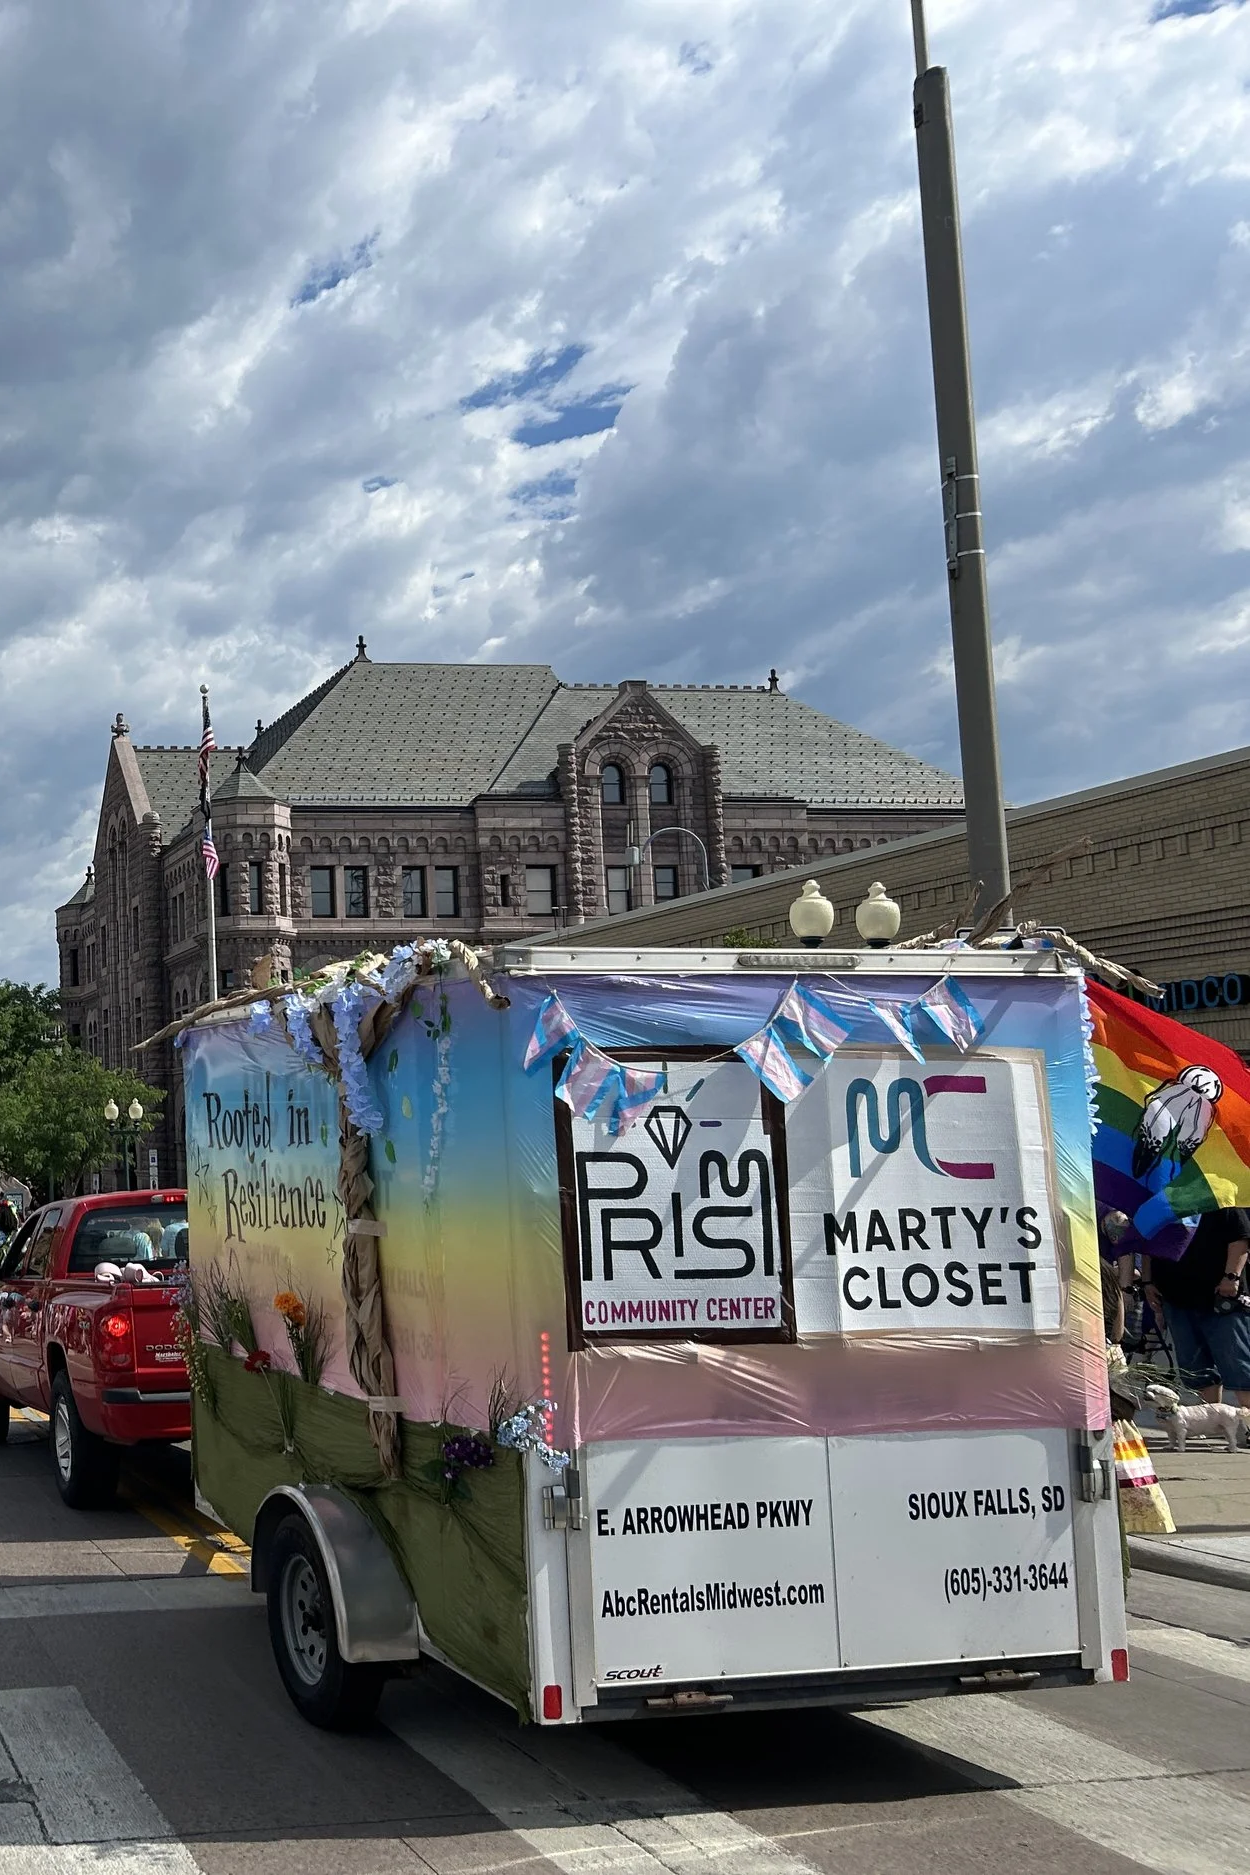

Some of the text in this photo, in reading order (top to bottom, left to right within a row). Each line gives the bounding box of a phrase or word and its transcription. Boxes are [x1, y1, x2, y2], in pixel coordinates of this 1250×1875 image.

[1145, 972, 1242, 1012] MIDCO
[203, 1071, 313, 1164] Rooted in
[221, 1159, 326, 1243] Resilience
[823, 1206, 1042, 1256] MARTY'S
[843, 1261, 1037, 1311] CLOSET
[584, 1297, 776, 1326] COMMUNITY CENTER
[596, 1498, 814, 1537] E. ARROWHEAD PKWY
[908, 1485, 1065, 1521] SIOUX FALLS, SD
[601, 1580, 825, 1618] AbcRentalsMidwest.com
[944, 1561, 1069, 1604] (605)-331-3644
[604, 1664, 664, 1681] scout
